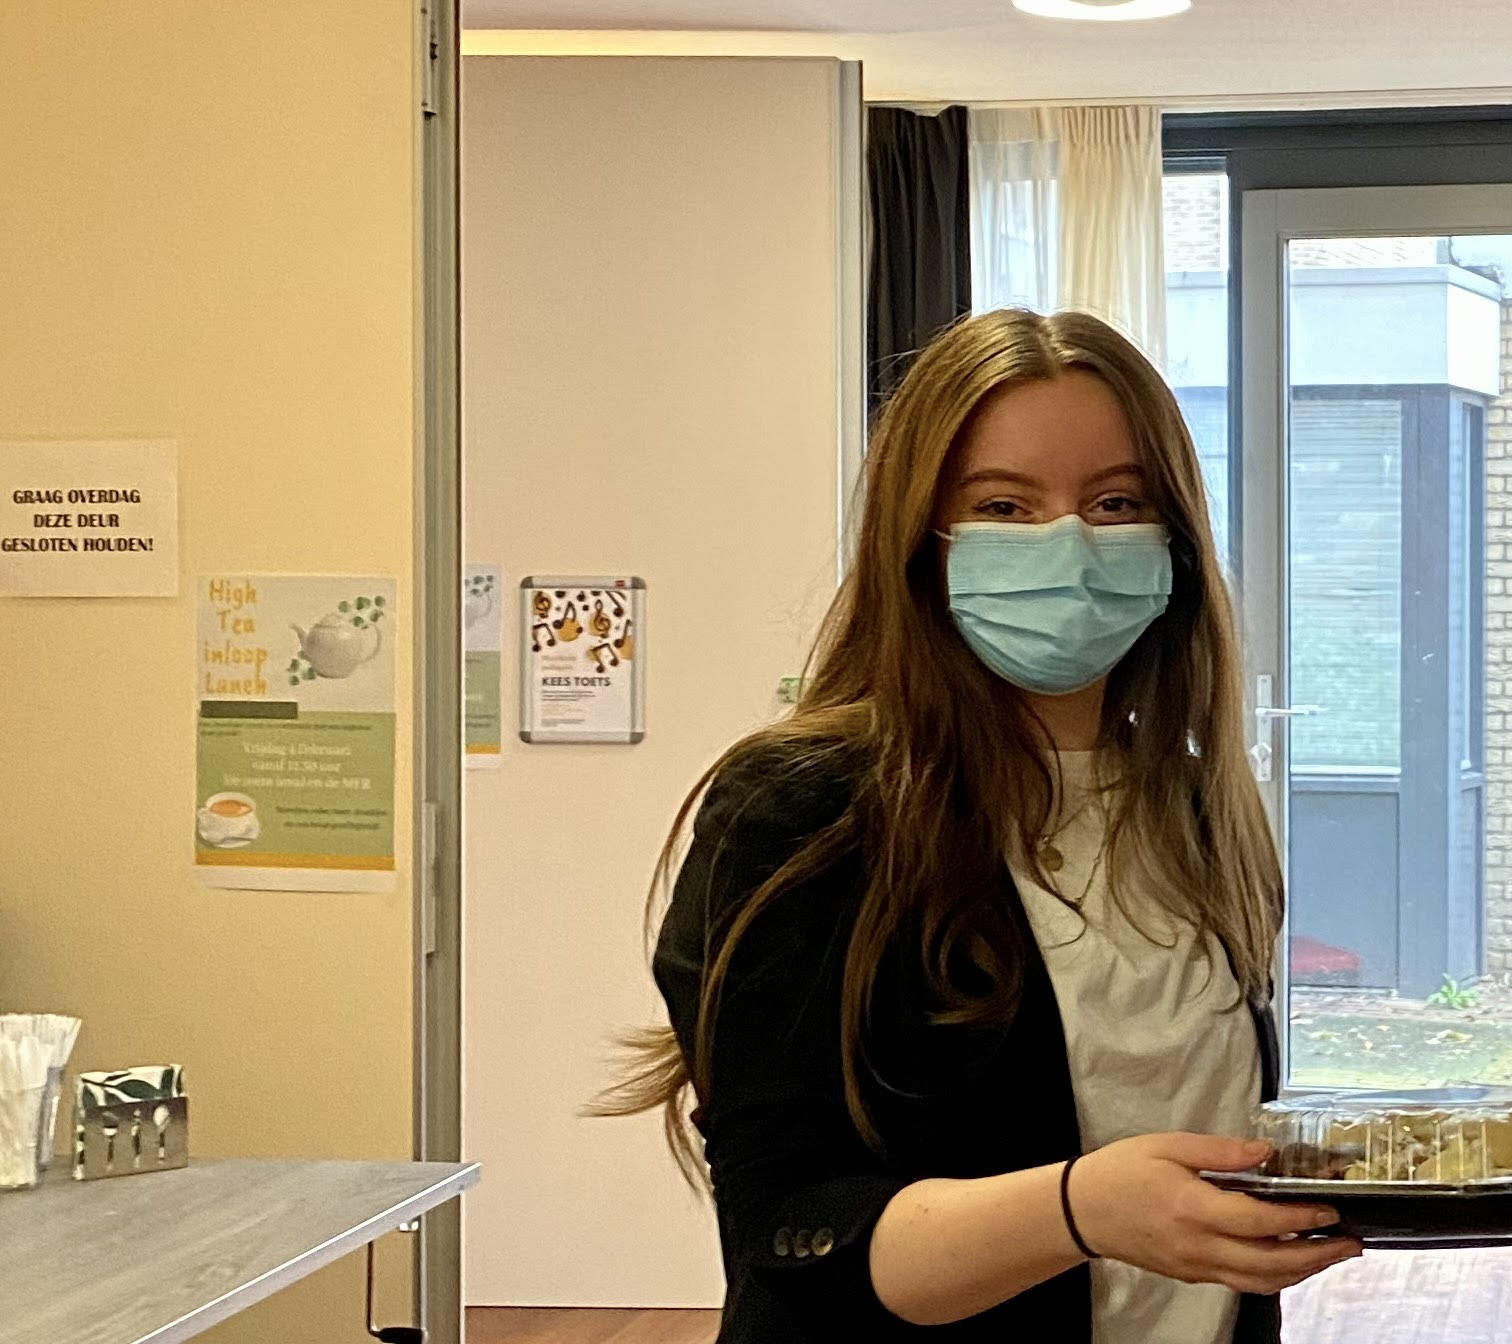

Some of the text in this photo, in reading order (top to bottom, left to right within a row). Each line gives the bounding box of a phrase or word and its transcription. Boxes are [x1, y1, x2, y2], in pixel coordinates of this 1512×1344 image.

[13, 489, 141, 504] GRAAG OVERDAG
[33, 513, 120, 528] DEZE DEUR
[1, 537, 154, 552] GESLOTEN HOUDEN!
[209, 579, 257, 610] High
[216, 608, 255, 635] Tea
[204, 639, 268, 671] inloop
[206, 672, 267, 695] Lunch
[541, 676, 612, 687] KEES TOETS
